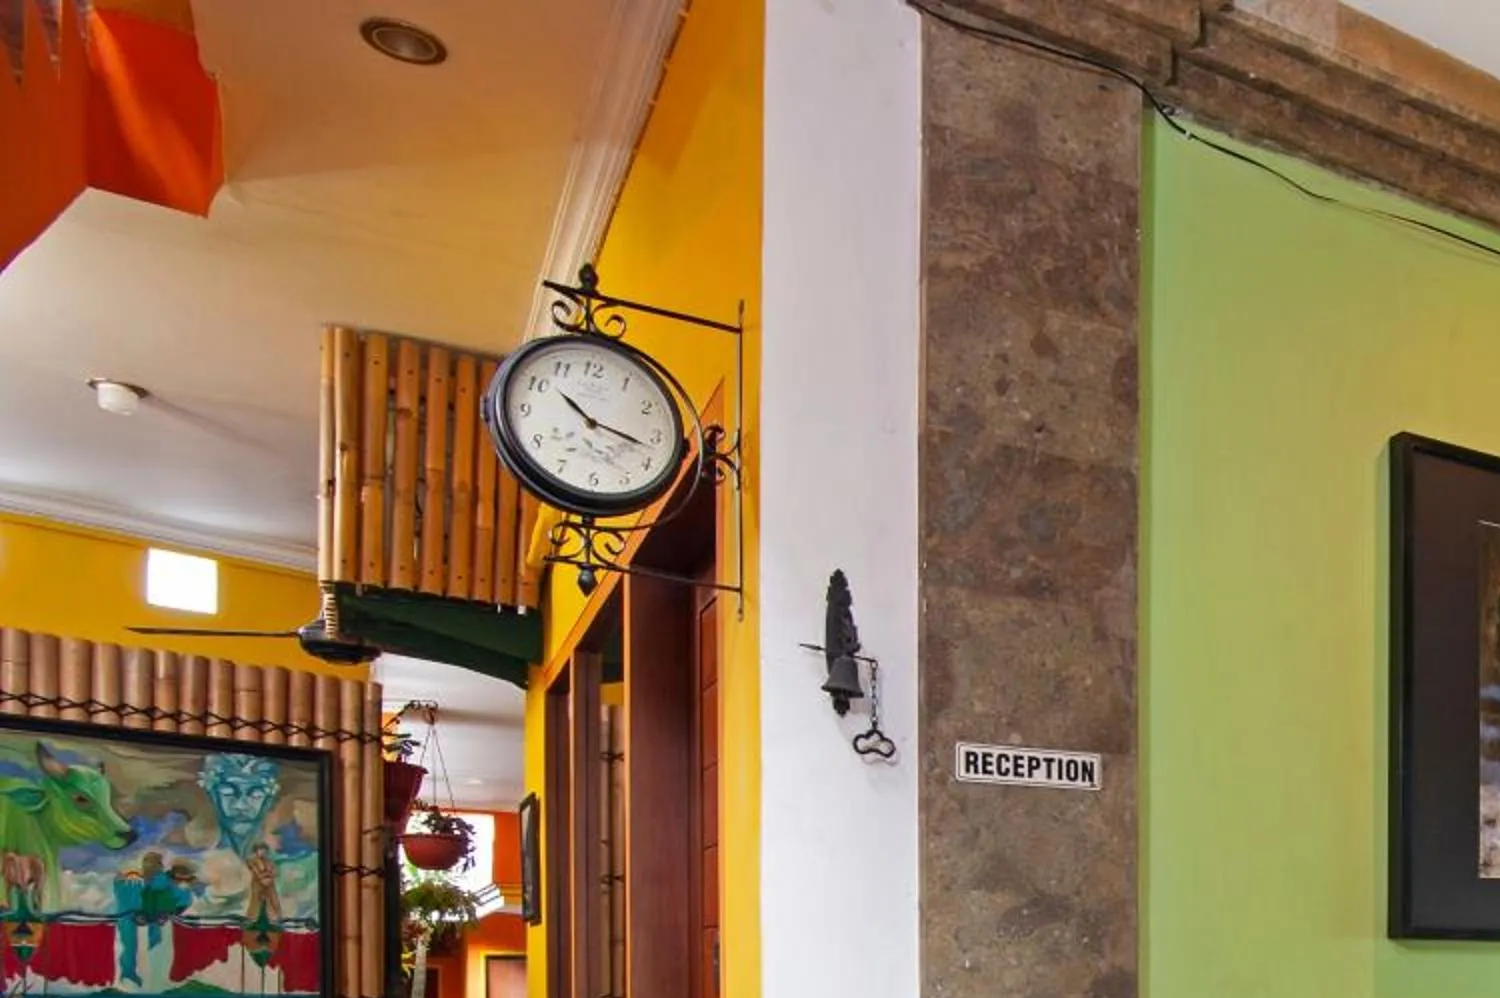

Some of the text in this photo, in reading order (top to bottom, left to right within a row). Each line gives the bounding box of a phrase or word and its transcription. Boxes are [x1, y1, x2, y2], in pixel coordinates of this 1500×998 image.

[554, 361, 571, 378] 11
[583, 361, 604, 379] 12
[528, 375, 549, 393] 10
[622, 377, 632, 391] 1
[520, 403, 531, 418] 9
[641, 400, 653, 415] 2
[532, 433, 543, 449] 8
[650, 429, 662, 445] 3
[556, 459, 567, 474] 7
[588, 472, 599, 487] 6
[965, 751, 1094, 783] RECEPTION
